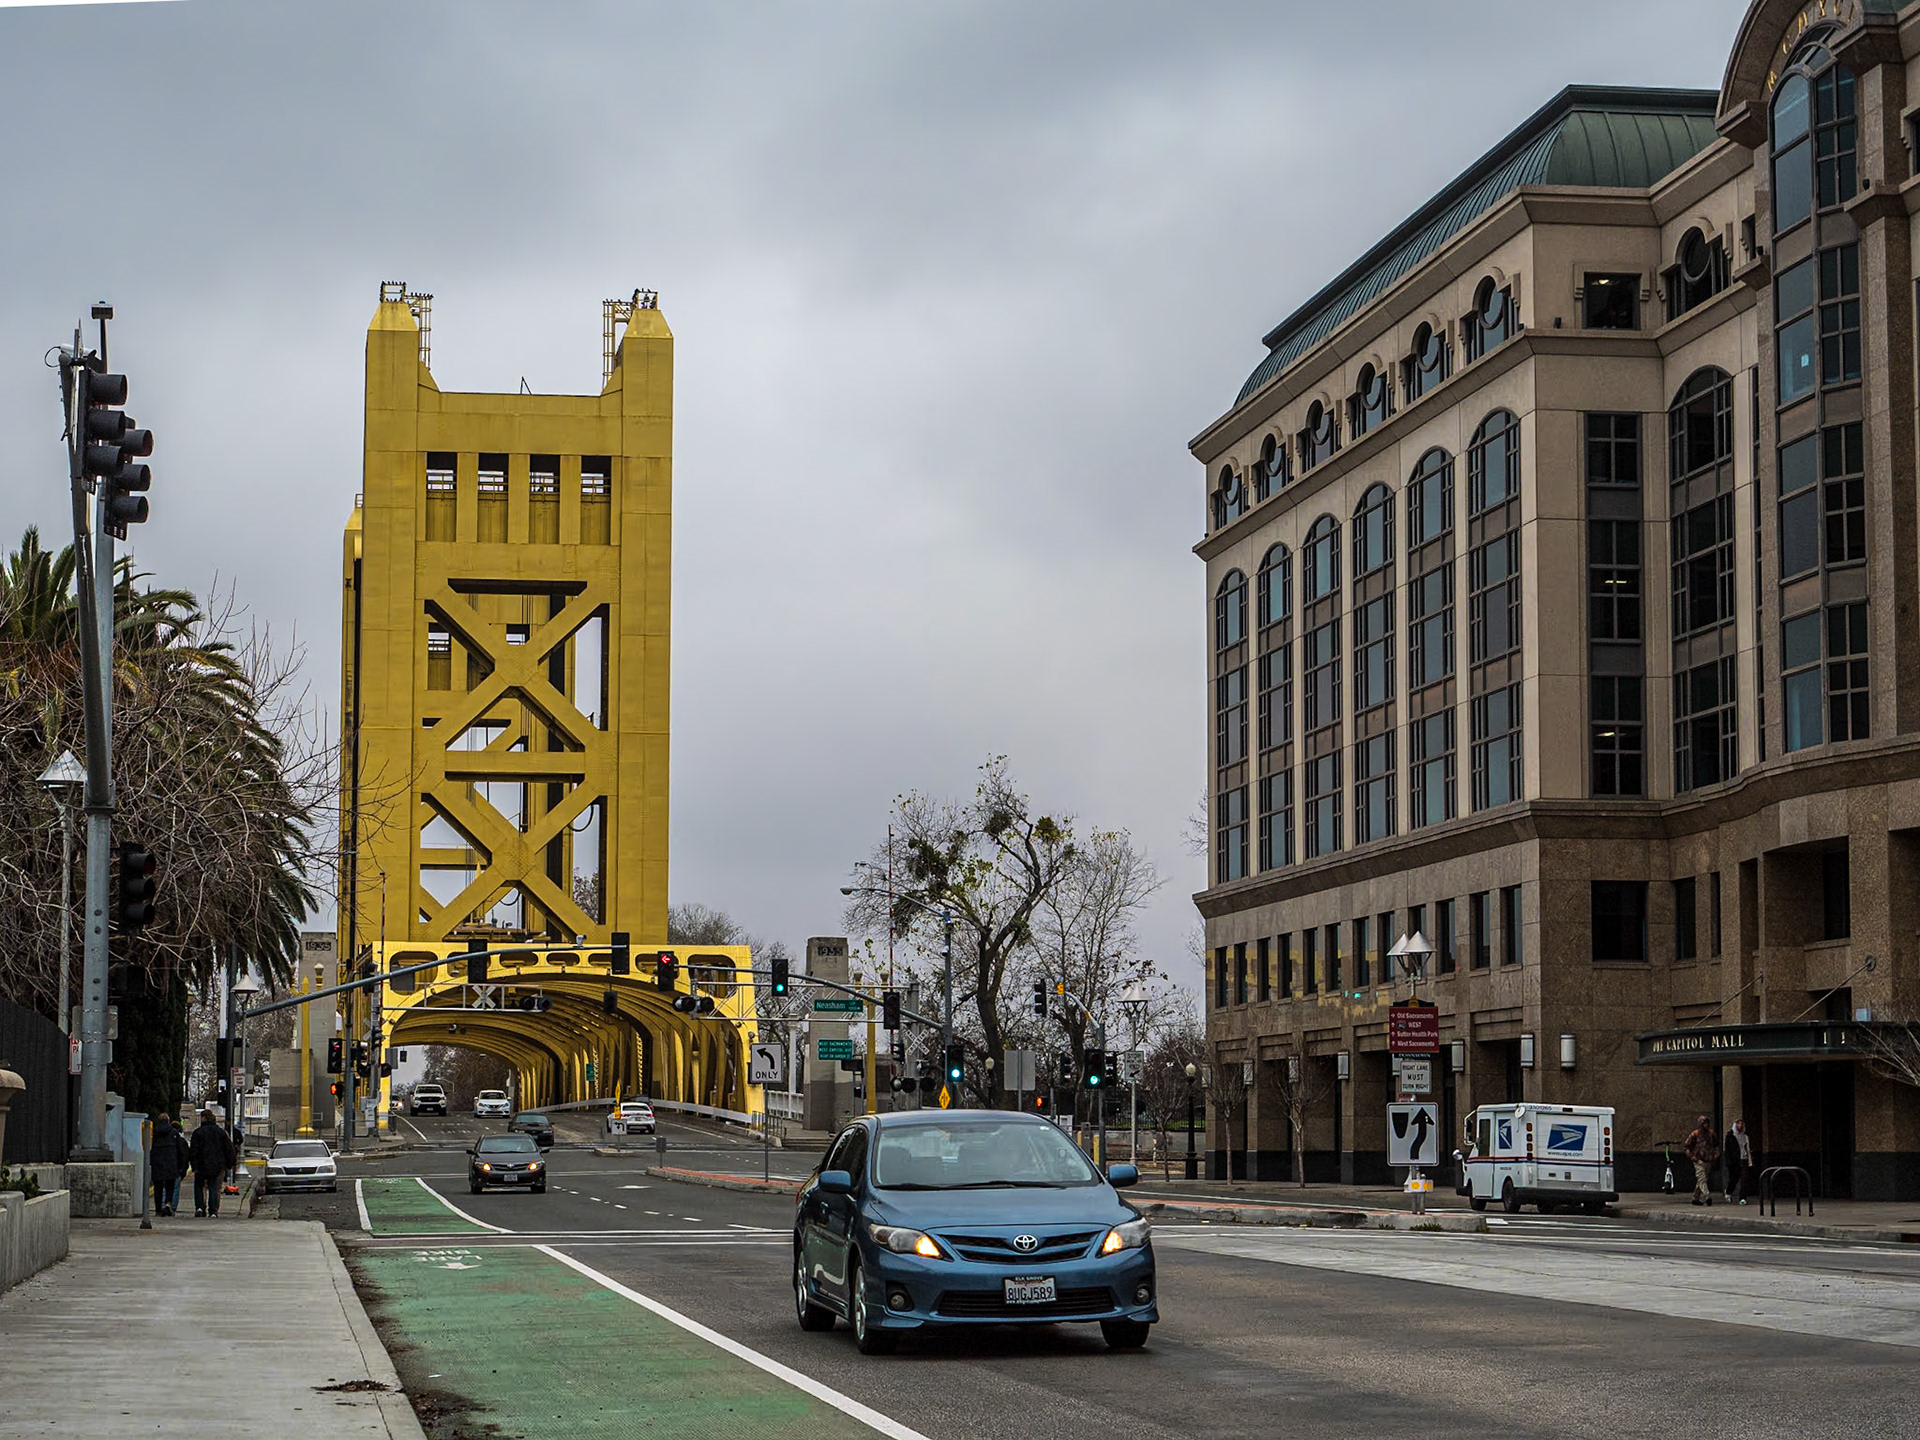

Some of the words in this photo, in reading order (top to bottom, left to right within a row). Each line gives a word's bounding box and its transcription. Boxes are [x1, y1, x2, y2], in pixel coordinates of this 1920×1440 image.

[306, 942, 331, 951] 1935
[816, 1001, 845, 1009] Neasham
[1666, 1036, 1705, 1051] CAPITOL
[1711, 1034, 1745, 1048] MALL
[755, 1071, 778, 1079] ONLY
[1007, 1286, 1053, 1300] 8UGJ589
